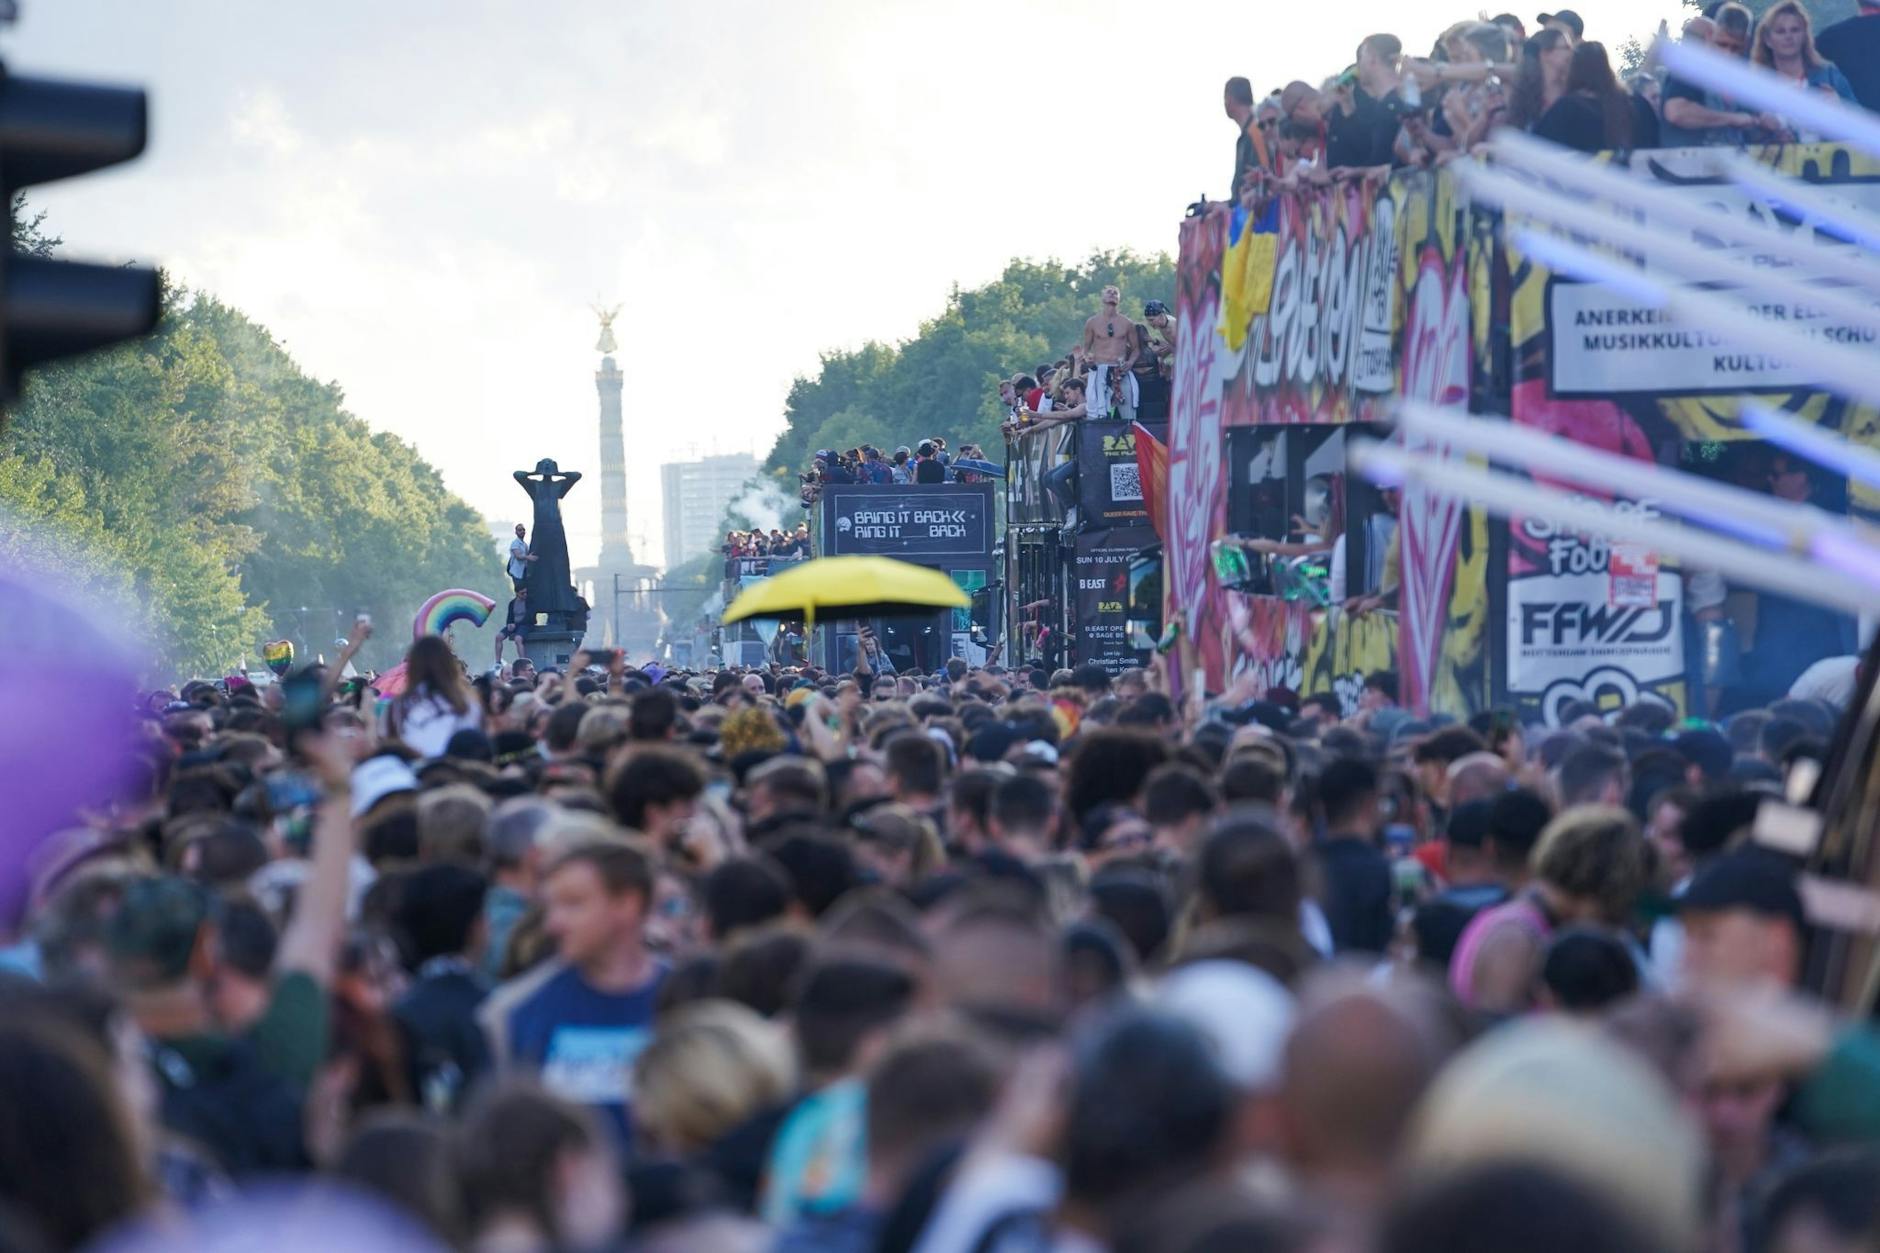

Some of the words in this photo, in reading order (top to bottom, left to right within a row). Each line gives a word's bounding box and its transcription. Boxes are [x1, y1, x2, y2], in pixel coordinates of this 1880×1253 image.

[1584, 331, 1725, 351] MUSIKKULTU
[854, 511, 896, 524] BRING
[898, 511, 910, 523] IT
[855, 526, 886, 538] RING
[889, 525, 902, 538] IT
[929, 524, 966, 538] BACK
[1076, 556, 1093, 564] SUN
[1104, 555, 1125, 563] JULY
[1088, 657, 1118, 665] Christian
[1119, 657, 1139, 665] Smith
